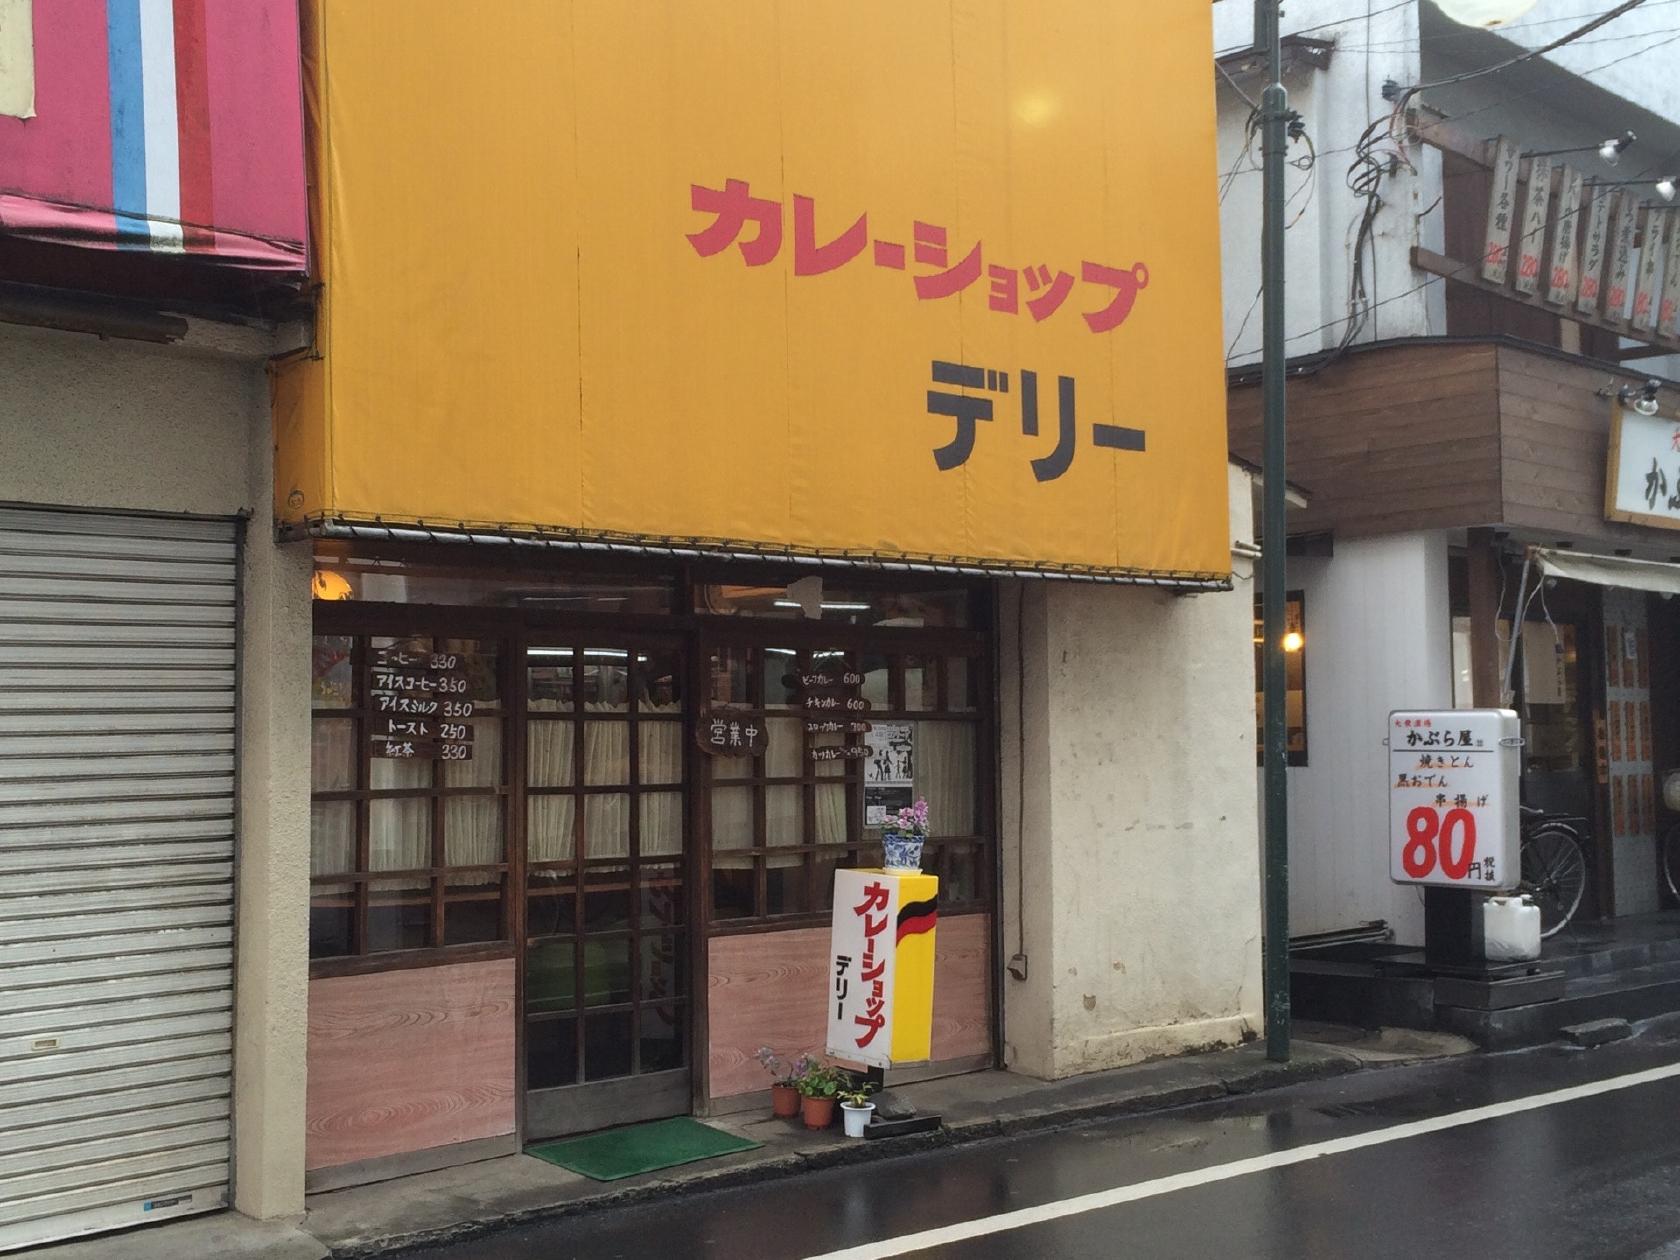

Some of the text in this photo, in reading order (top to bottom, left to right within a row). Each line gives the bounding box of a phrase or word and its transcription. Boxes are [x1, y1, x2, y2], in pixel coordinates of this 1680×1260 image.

[685, 178, 1149, 333] カレーショップ
[927, 360, 1146, 482] デリー
[430, 653, 456, 669] 330
[376, 674, 467, 693] アイスコーヒー 350
[843, 673, 860, 684] 600
[379, 696, 473, 717] アイスミルク 350
[847, 698, 865, 710] 600
[388, 718, 466, 739] トースト 250
[711, 718, 759, 747] 営業中
[1407, 730, 1474, 747] かぶら屋
[385, 742, 467, 760] 紅茶 330
[1419, 754, 1474, 768] 焼きとん
[1397, 774, 1447, 788] 黒おでん
[1435, 794, 1488, 808] 串揚げ
[854, 881, 890, 1049] カレーショップ
[836, 955, 852, 1020] デリー
